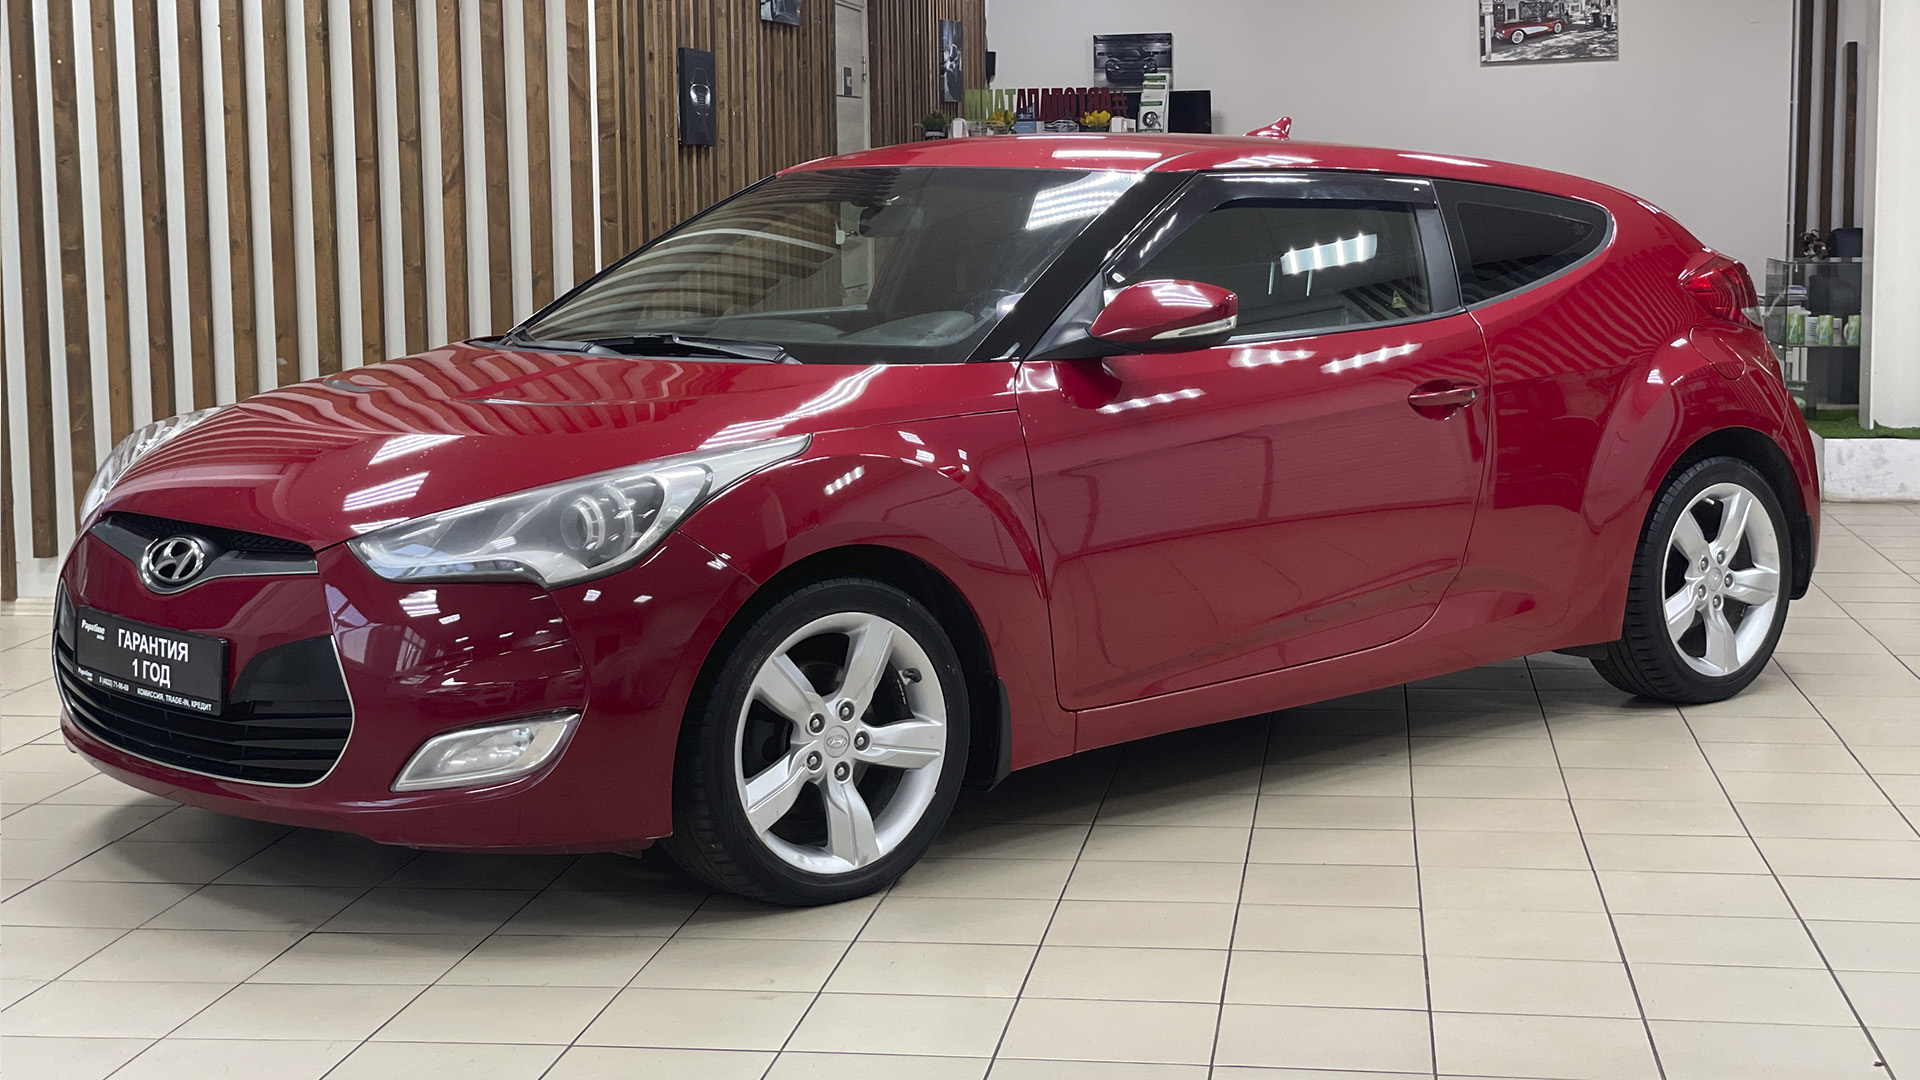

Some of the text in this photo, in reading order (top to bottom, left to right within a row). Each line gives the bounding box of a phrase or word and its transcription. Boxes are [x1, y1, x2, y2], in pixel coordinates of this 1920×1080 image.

[118, 628, 189, 663] ГАРАНТИЯ
[132, 658, 171, 688] 1 ГОД
[137, 687, 212, 712] КОМИССИЯ, TRADE-IN, КРЕДИТ
